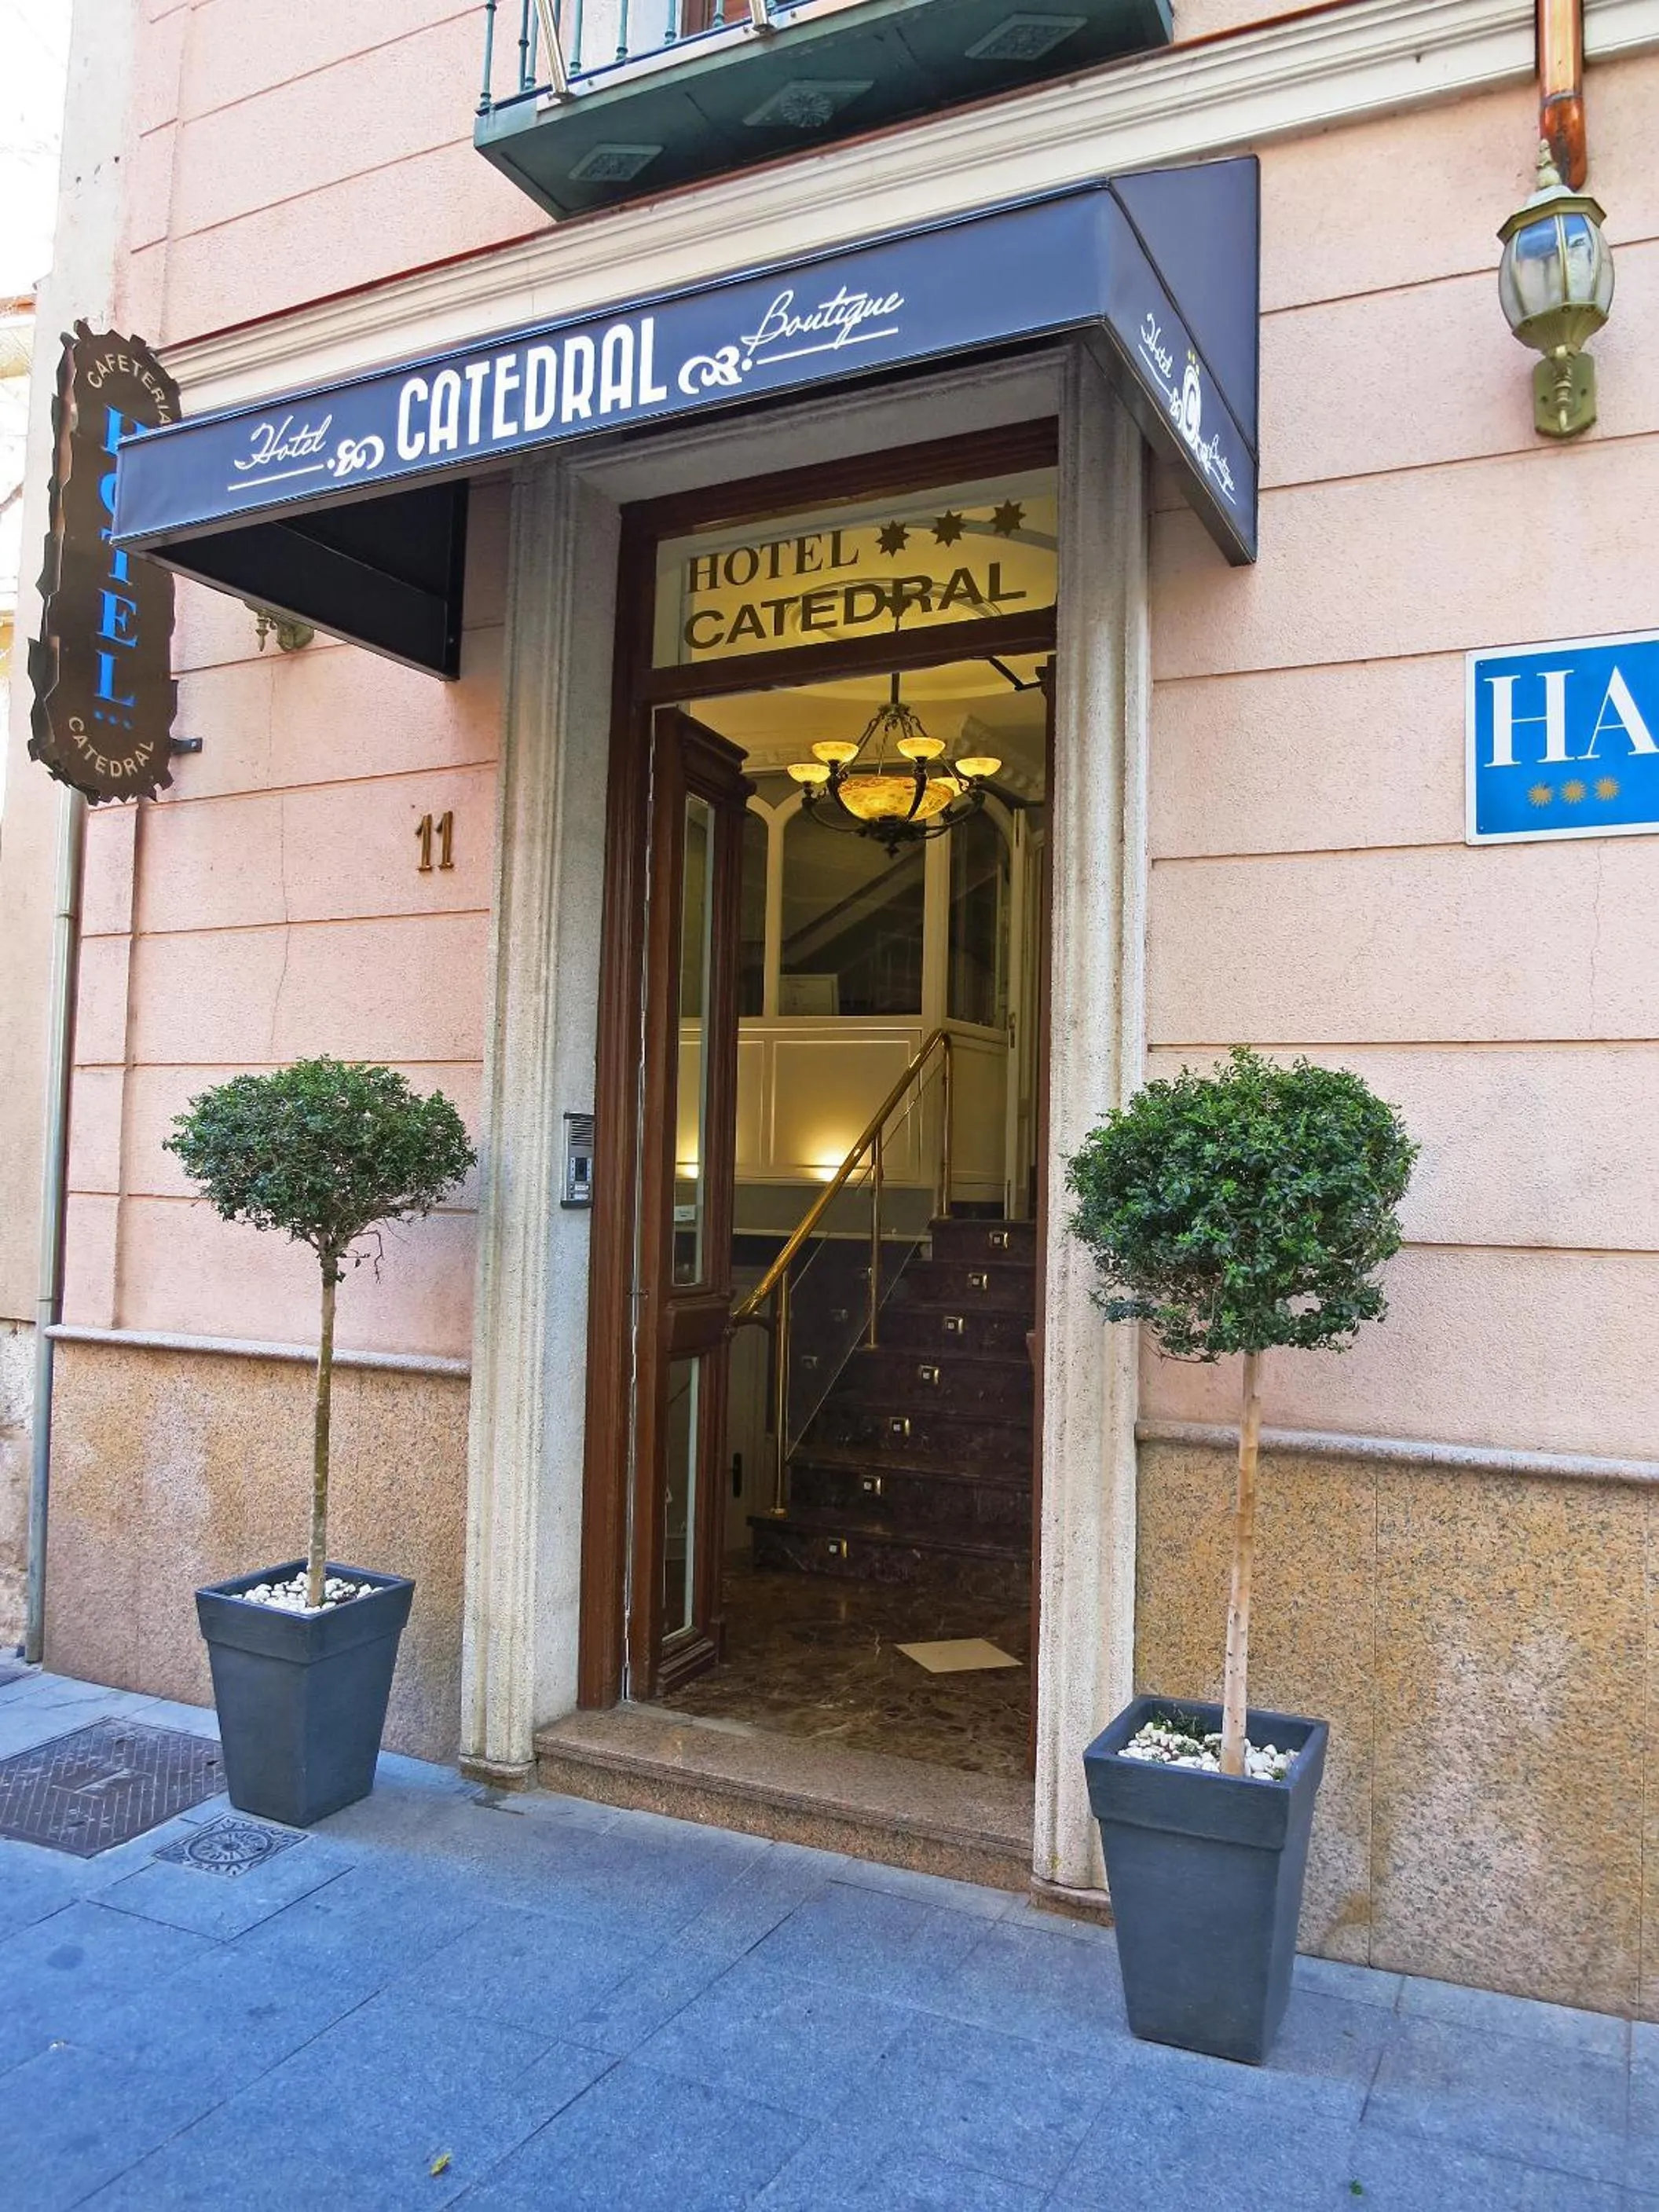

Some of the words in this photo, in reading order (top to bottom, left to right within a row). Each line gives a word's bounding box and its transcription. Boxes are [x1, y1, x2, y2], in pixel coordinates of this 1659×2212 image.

[87, 353, 173, 425] CAFETERIA
[234, 414, 332, 471] Hotel
[397, 317, 668, 461] CATEDRAL
[741, 285, 904, 357] Boutique
[688, 529, 859, 594] HOTEL
[683, 562, 1027, 650] CATEDRAL
[68, 716, 154, 778] CATEDRAL
[1483, 665, 1659, 767] HA
[414, 810, 455, 872] 11
